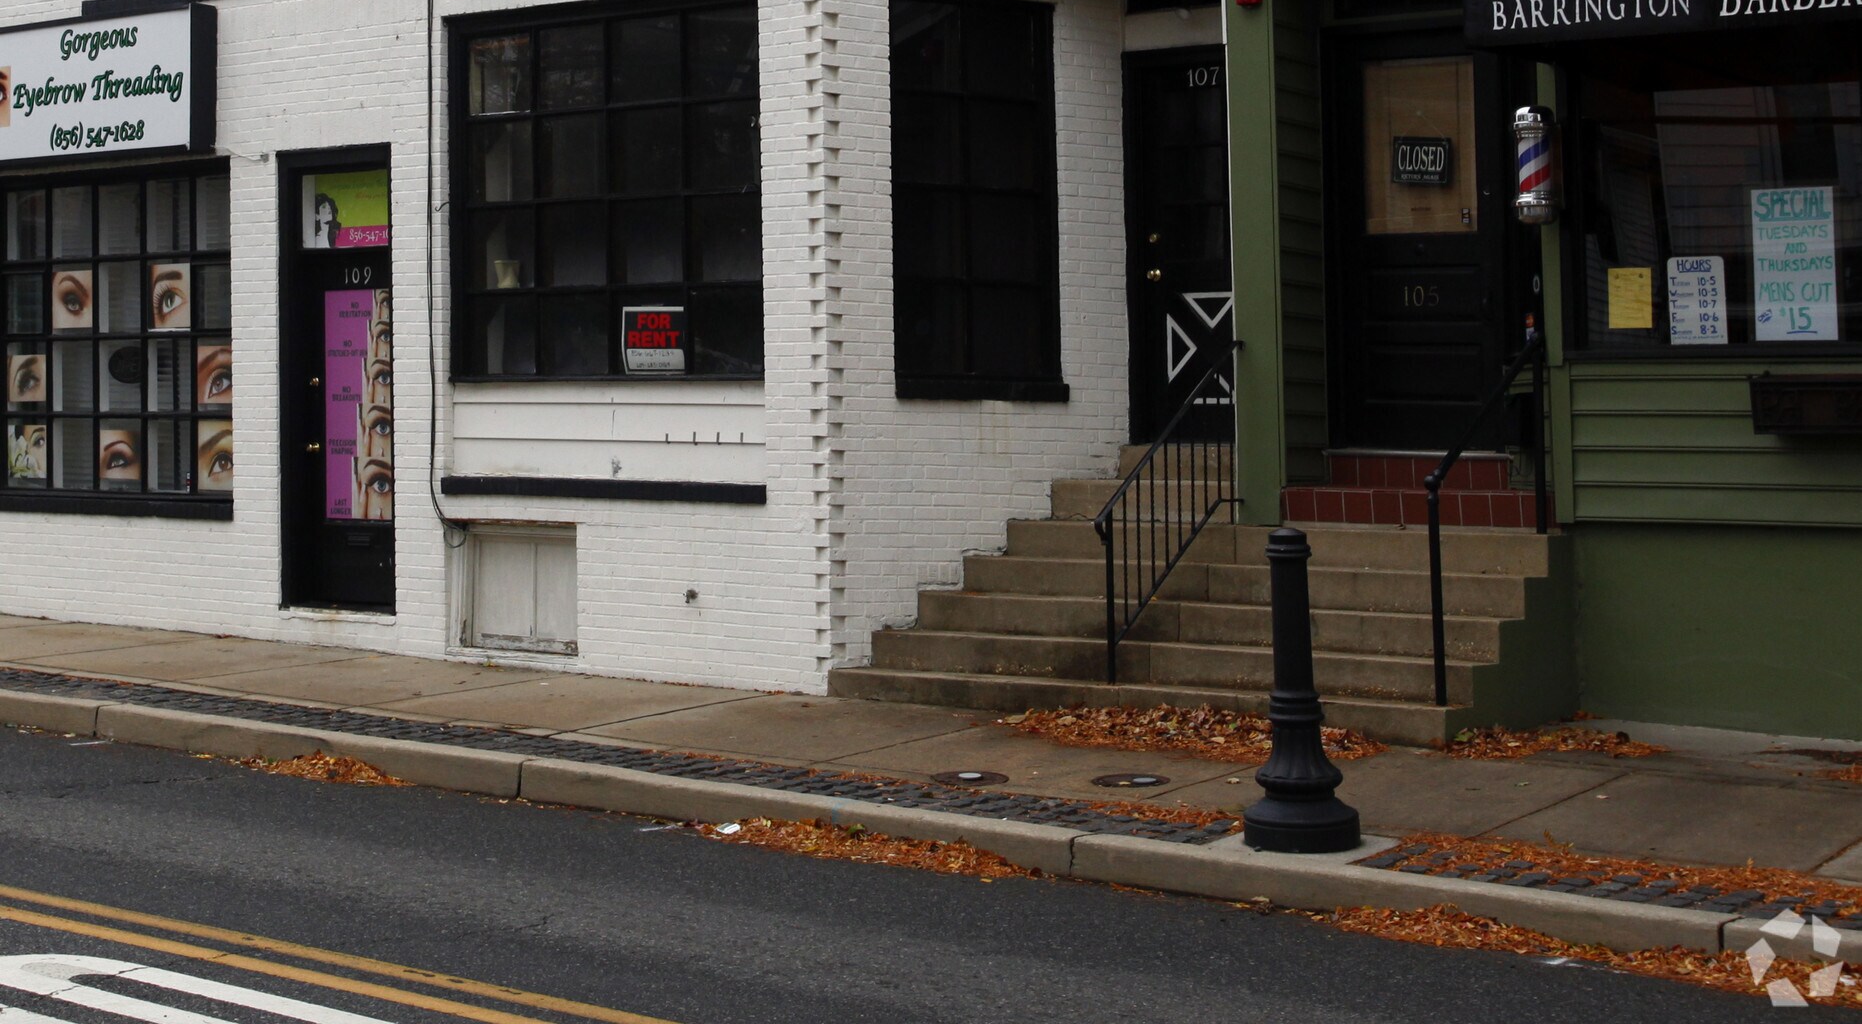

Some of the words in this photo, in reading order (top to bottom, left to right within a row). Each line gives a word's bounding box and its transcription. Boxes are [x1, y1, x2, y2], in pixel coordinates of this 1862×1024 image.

[60, 26, 139, 61] Gorgeous
[1186, 66, 1220, 87] 107
[13, 77, 87, 117] Eyebrow
[91, 64, 184, 102] Threading
[50, 121, 84, 151] (856)
[85, 119, 145, 148] 547-1628
[1398, 144, 1445, 171] CLOSED
[1754, 189, 1831, 220] SPECIAL
[1756, 224, 1828, 240] TUESDAYS
[1784, 241, 1808, 255] AND
[1676, 259, 1712, 272] HOURS
[1757, 255, 1833, 272] THURSDAYS
[345, 266, 372, 285] 109
[1404, 285, 1440, 306] 105
[1758, 280, 1795, 303] MENS
[1801, 281, 1833, 303] CUT
[637, 312, 672, 329] FOR
[627, 330, 680, 348] RENT
